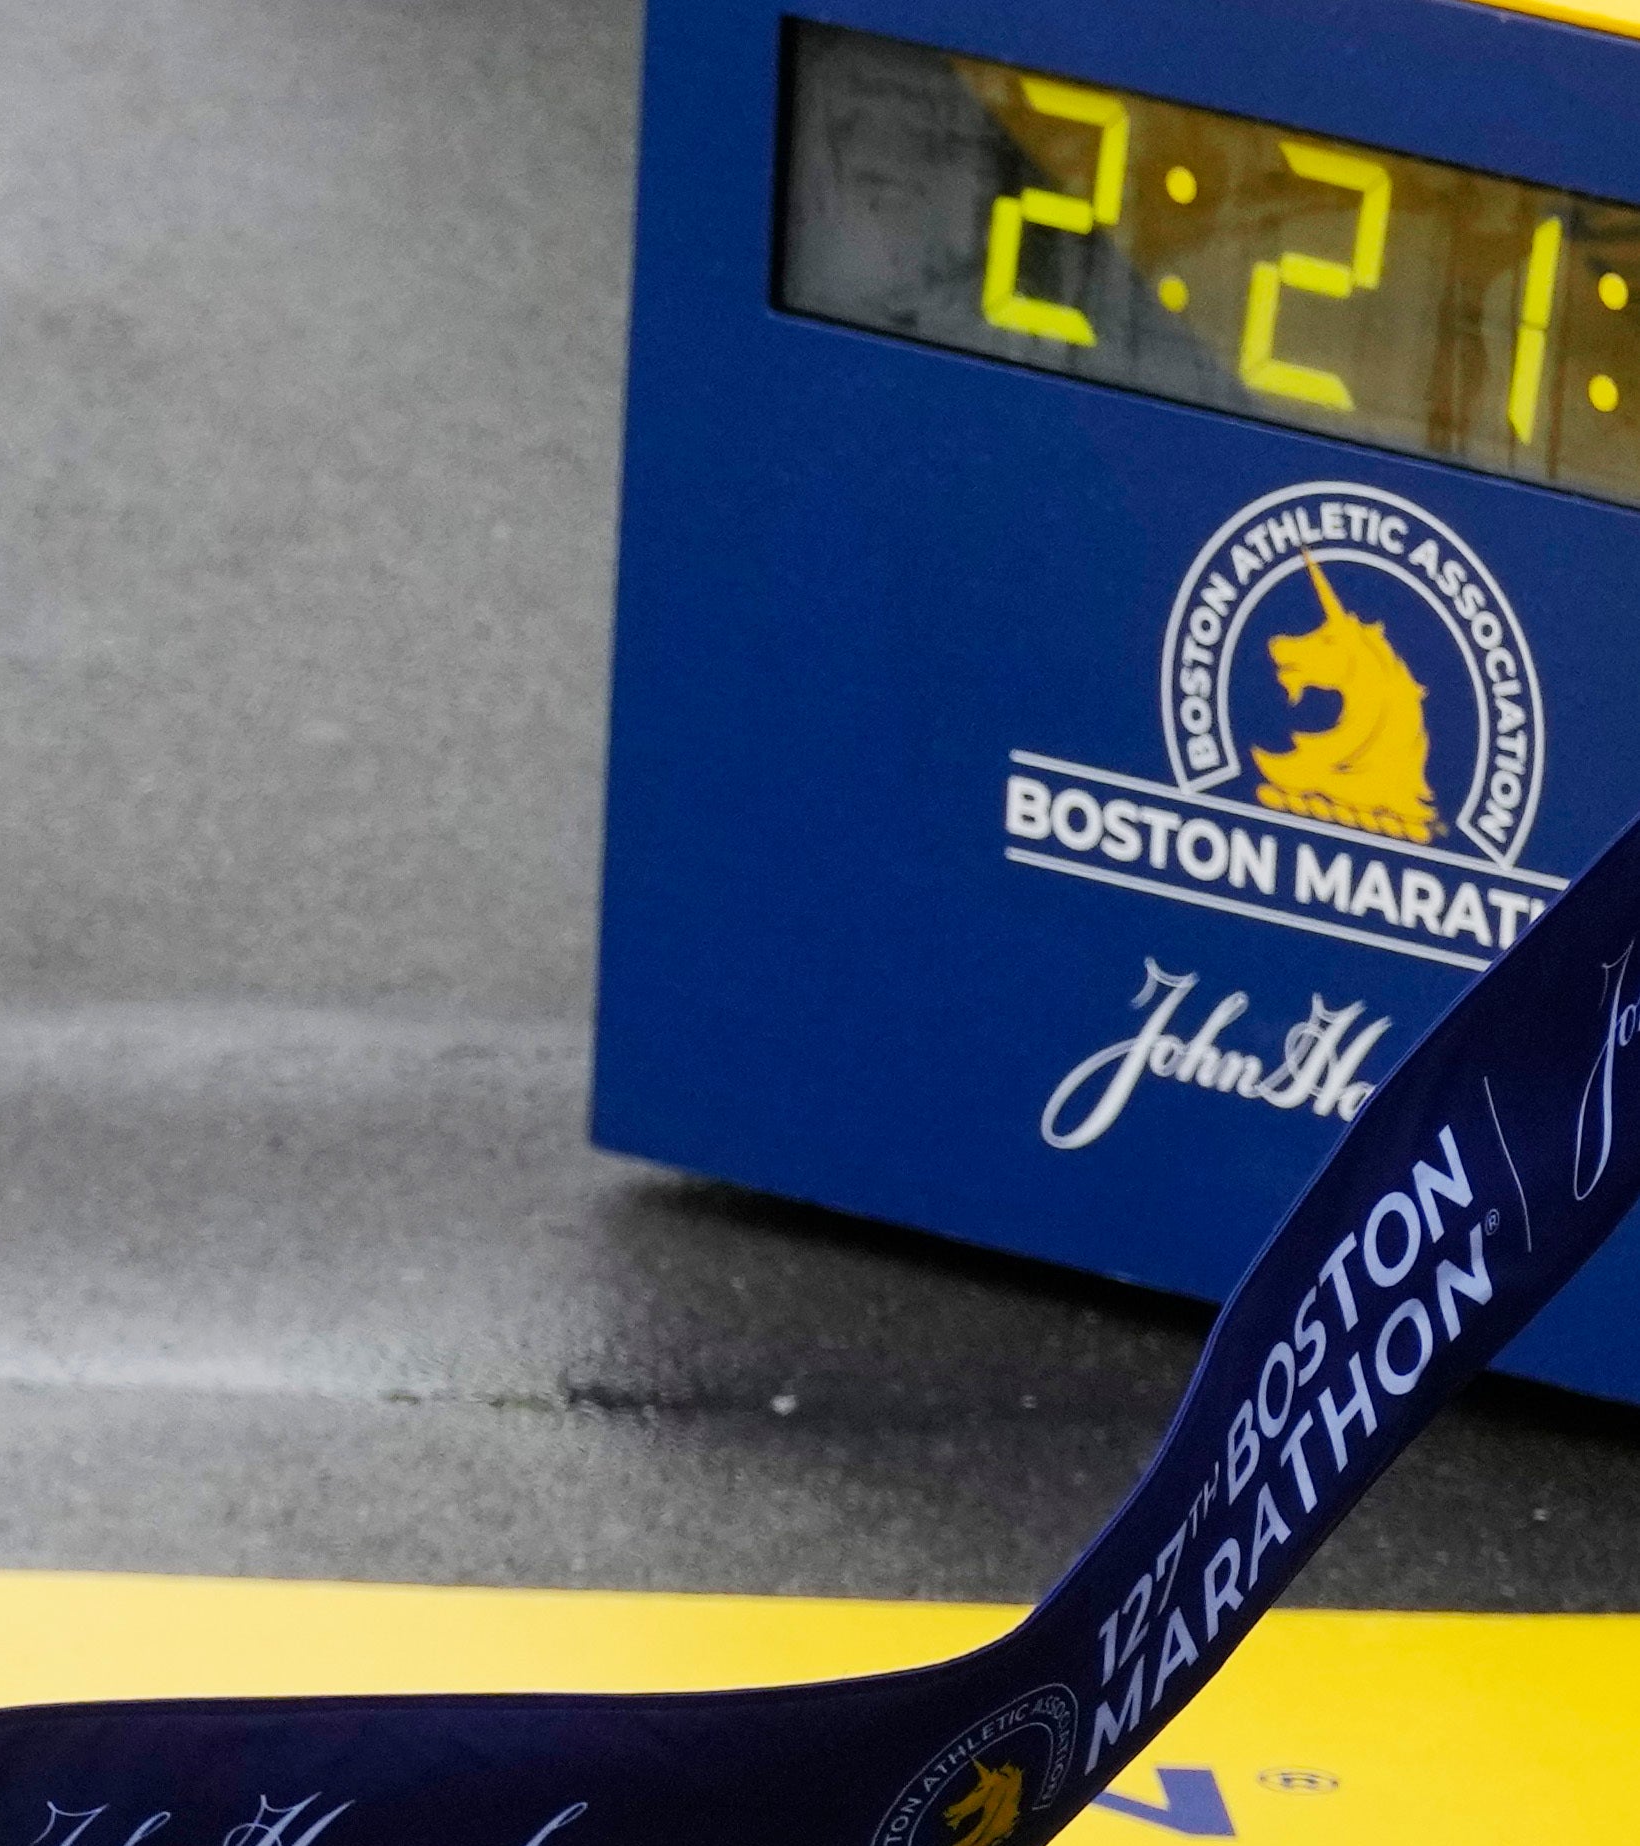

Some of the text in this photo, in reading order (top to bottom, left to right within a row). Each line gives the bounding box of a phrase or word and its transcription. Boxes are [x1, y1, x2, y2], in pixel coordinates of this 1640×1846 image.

[1179, 501, 1525, 844] BOSTON ATHLETIC ASSOCIATION
[1005, 775, 1550, 951] BOSTON MARAT
[1040, 956, 1262, 1150] John
[1573, 939, 1640, 1201] Jo
[1098, 1460, 1220, 1687] 127TH
[1227, 1123, 1474, 1506] BOSTON
[923, 1703, 1029, 1793] ATHLETIC
